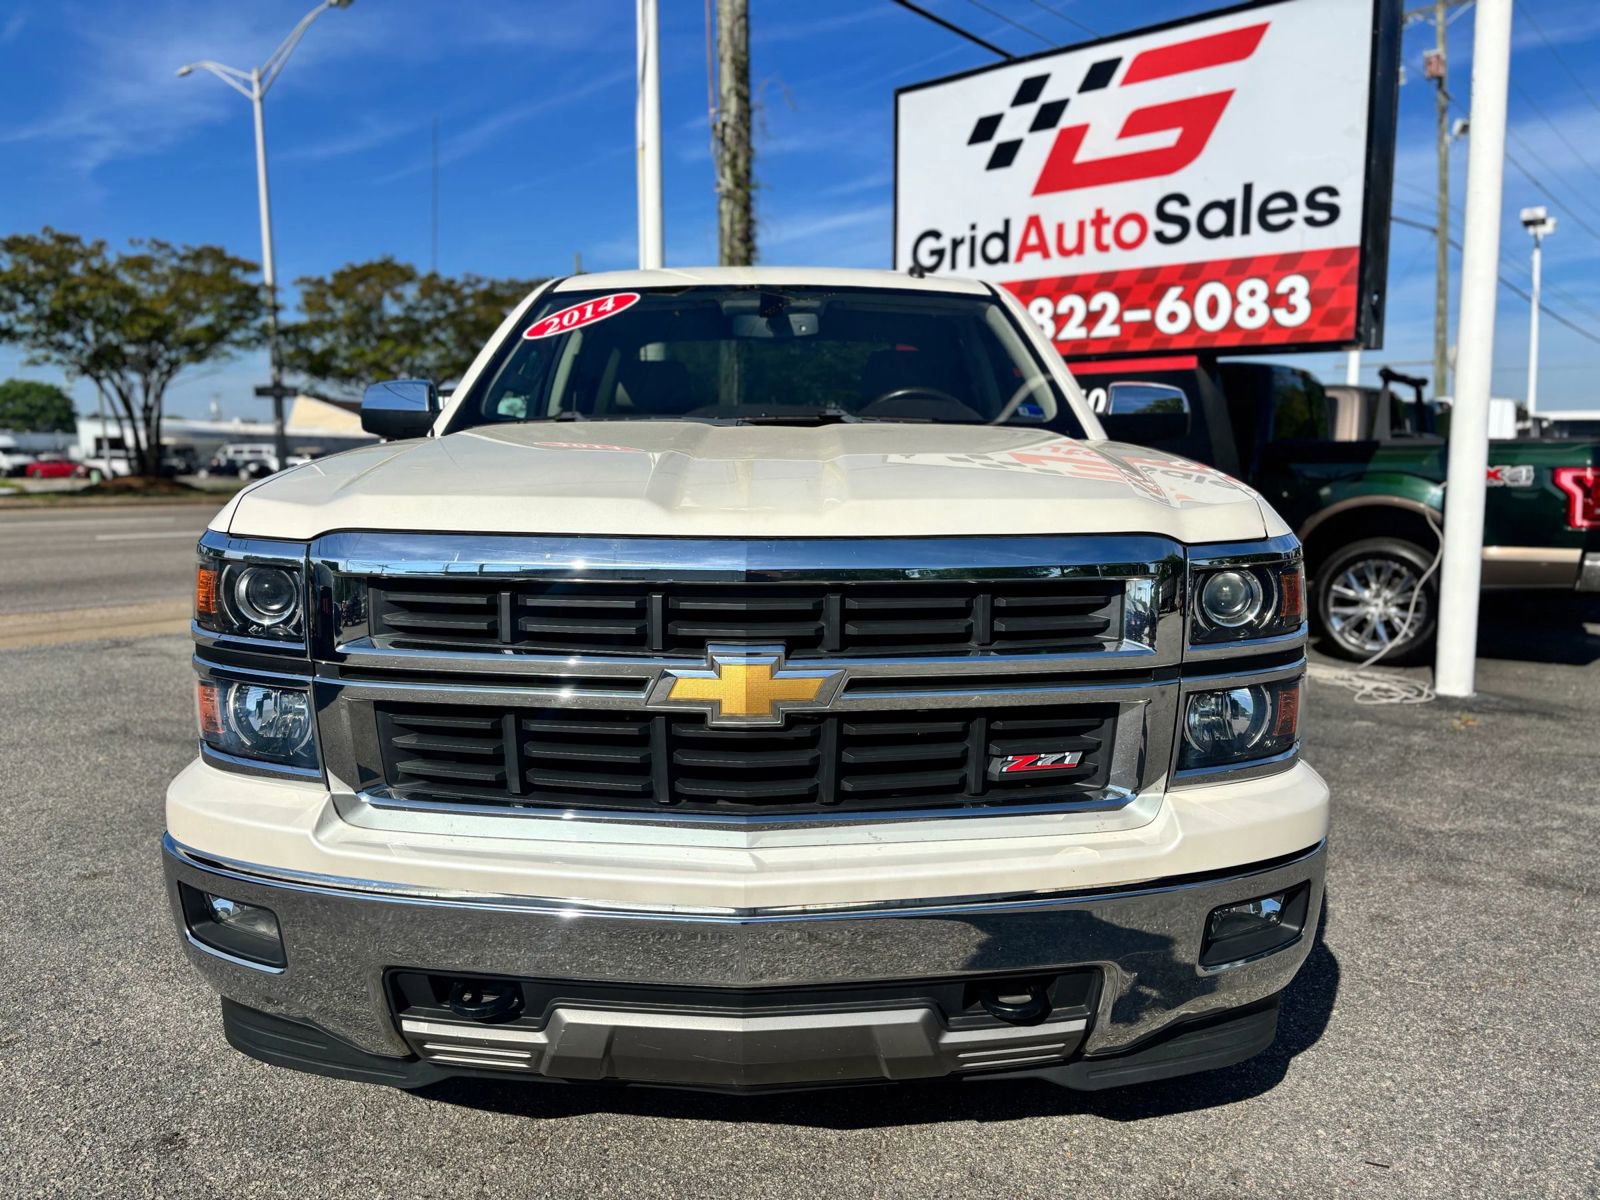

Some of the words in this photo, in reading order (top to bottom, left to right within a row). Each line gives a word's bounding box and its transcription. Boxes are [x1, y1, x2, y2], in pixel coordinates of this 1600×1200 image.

[544, 297, 615, 335] 2014
[1028, 274, 1312, 341] 822-6083
[1002, 751, 1082, 773] Z71
